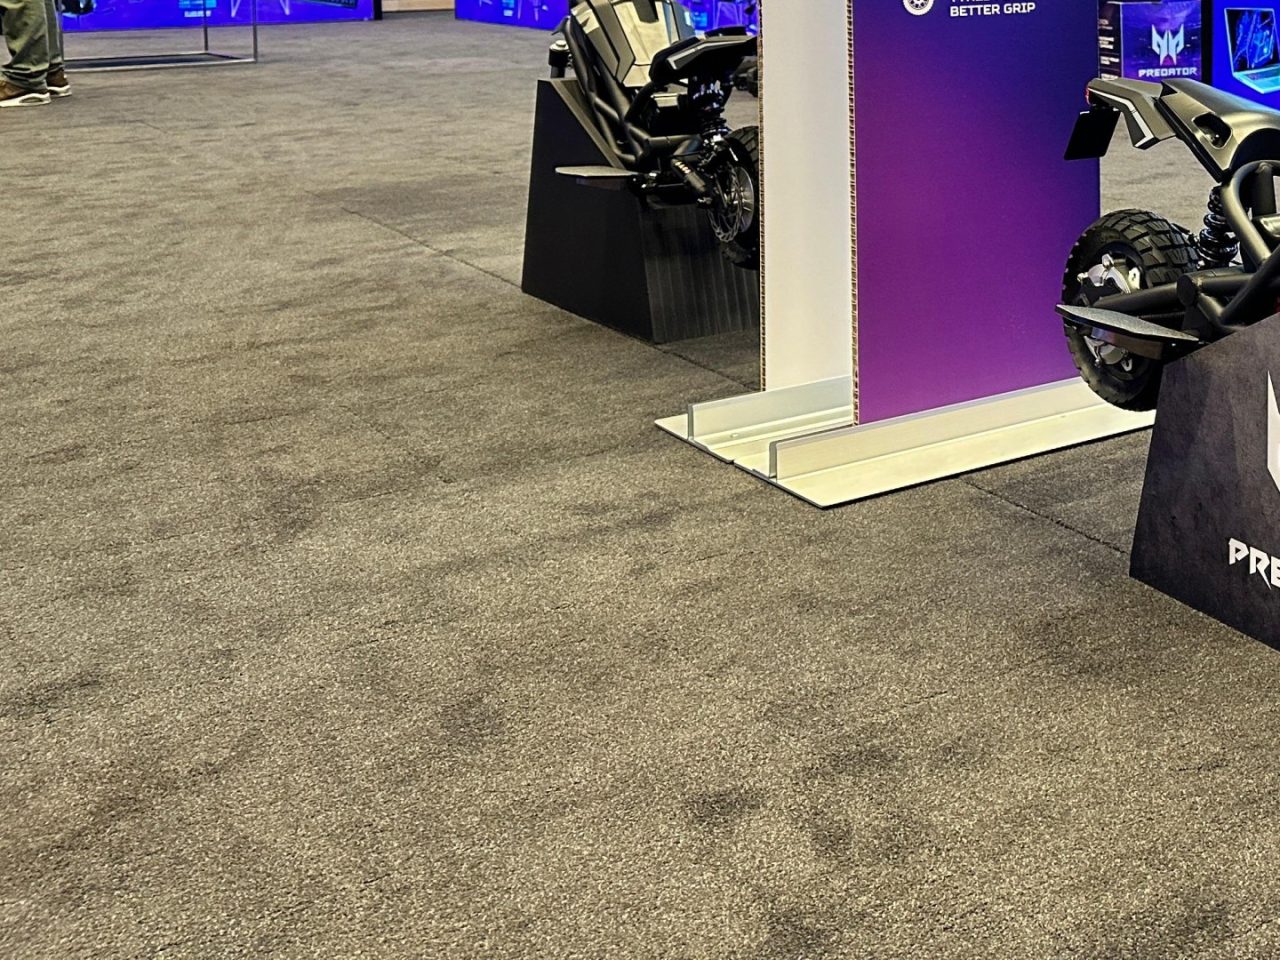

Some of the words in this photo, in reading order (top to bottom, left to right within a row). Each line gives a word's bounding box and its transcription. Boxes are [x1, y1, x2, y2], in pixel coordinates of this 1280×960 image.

[950, 4, 1001, 17] BETTER
[1003, 2, 1036, 14] GRIP
[1138, 67, 1198, 78] PREDATOR
